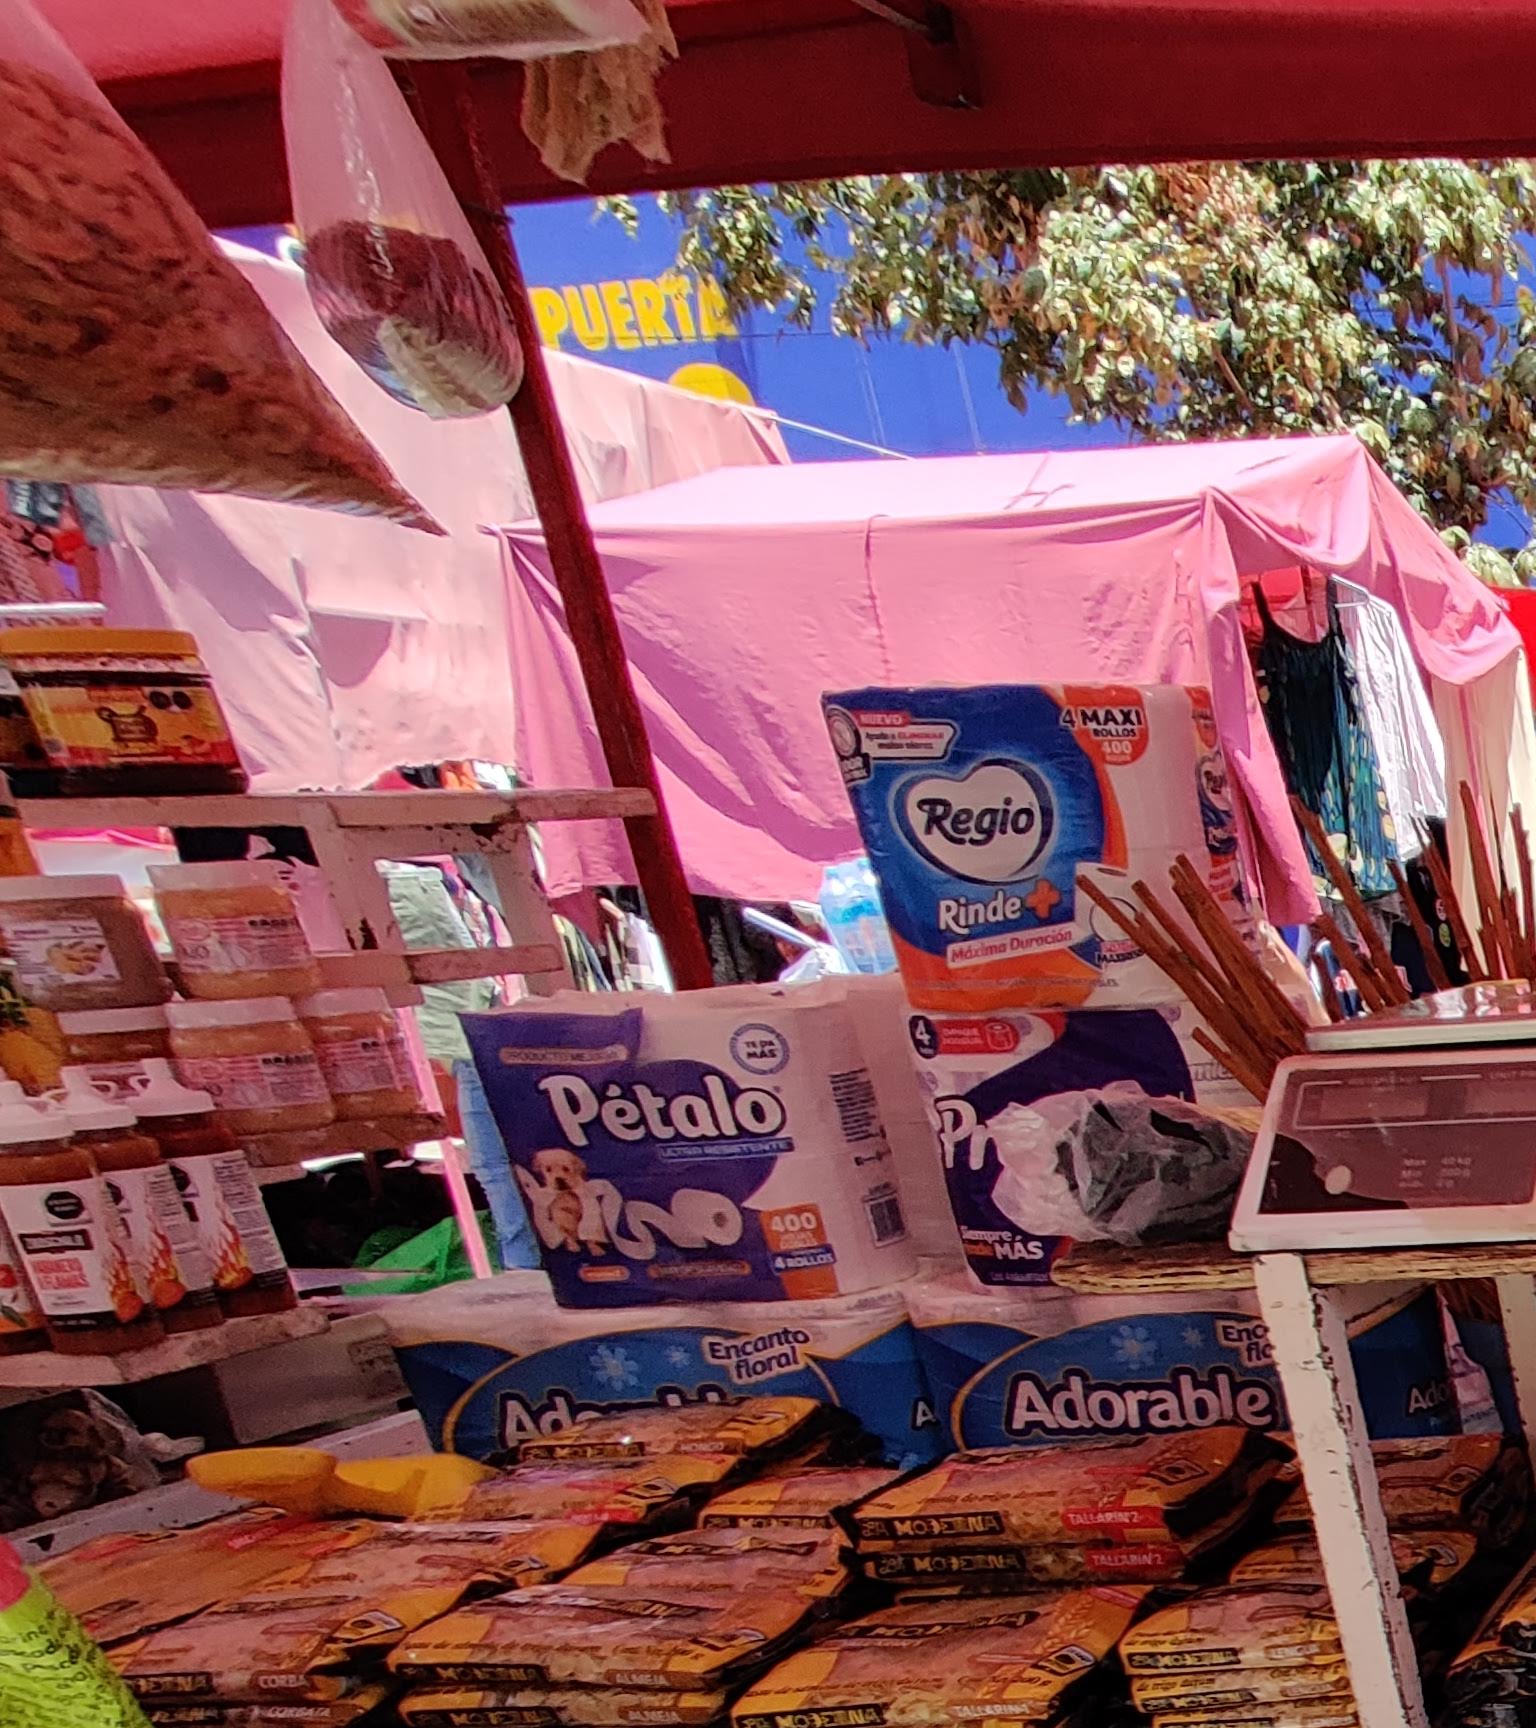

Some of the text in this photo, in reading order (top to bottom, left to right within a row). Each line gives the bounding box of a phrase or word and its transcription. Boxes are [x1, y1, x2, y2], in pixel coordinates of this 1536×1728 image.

[528, 268, 738, 350] PUERTA
[1062, 708, 1142, 728] 4 MAXI
[1093, 728, 1137, 738] ROLLOS
[1102, 740, 1133, 753] 400
[917, 797, 1035, 846] Regio
[938, 889, 1022, 935] Rinde
[950, 930, 1073, 963] Máxima Duración
[744, 1039, 775, 1050] TE DA
[746, 1047, 778, 1061] MÁS
[538, 1073, 782, 1146] Pétalo
[770, 1212, 817, 1233] 400
[994, 1235, 1045, 1260] MÁS
[774, 1252, 834, 1270] 4 ROLLOS
[708, 1326, 810, 1360] Encanto
[735, 1346, 800, 1381] floral
[1010, 1372, 1274, 1431] Adorable
[259, 1675, 310, 1689] CORBA
